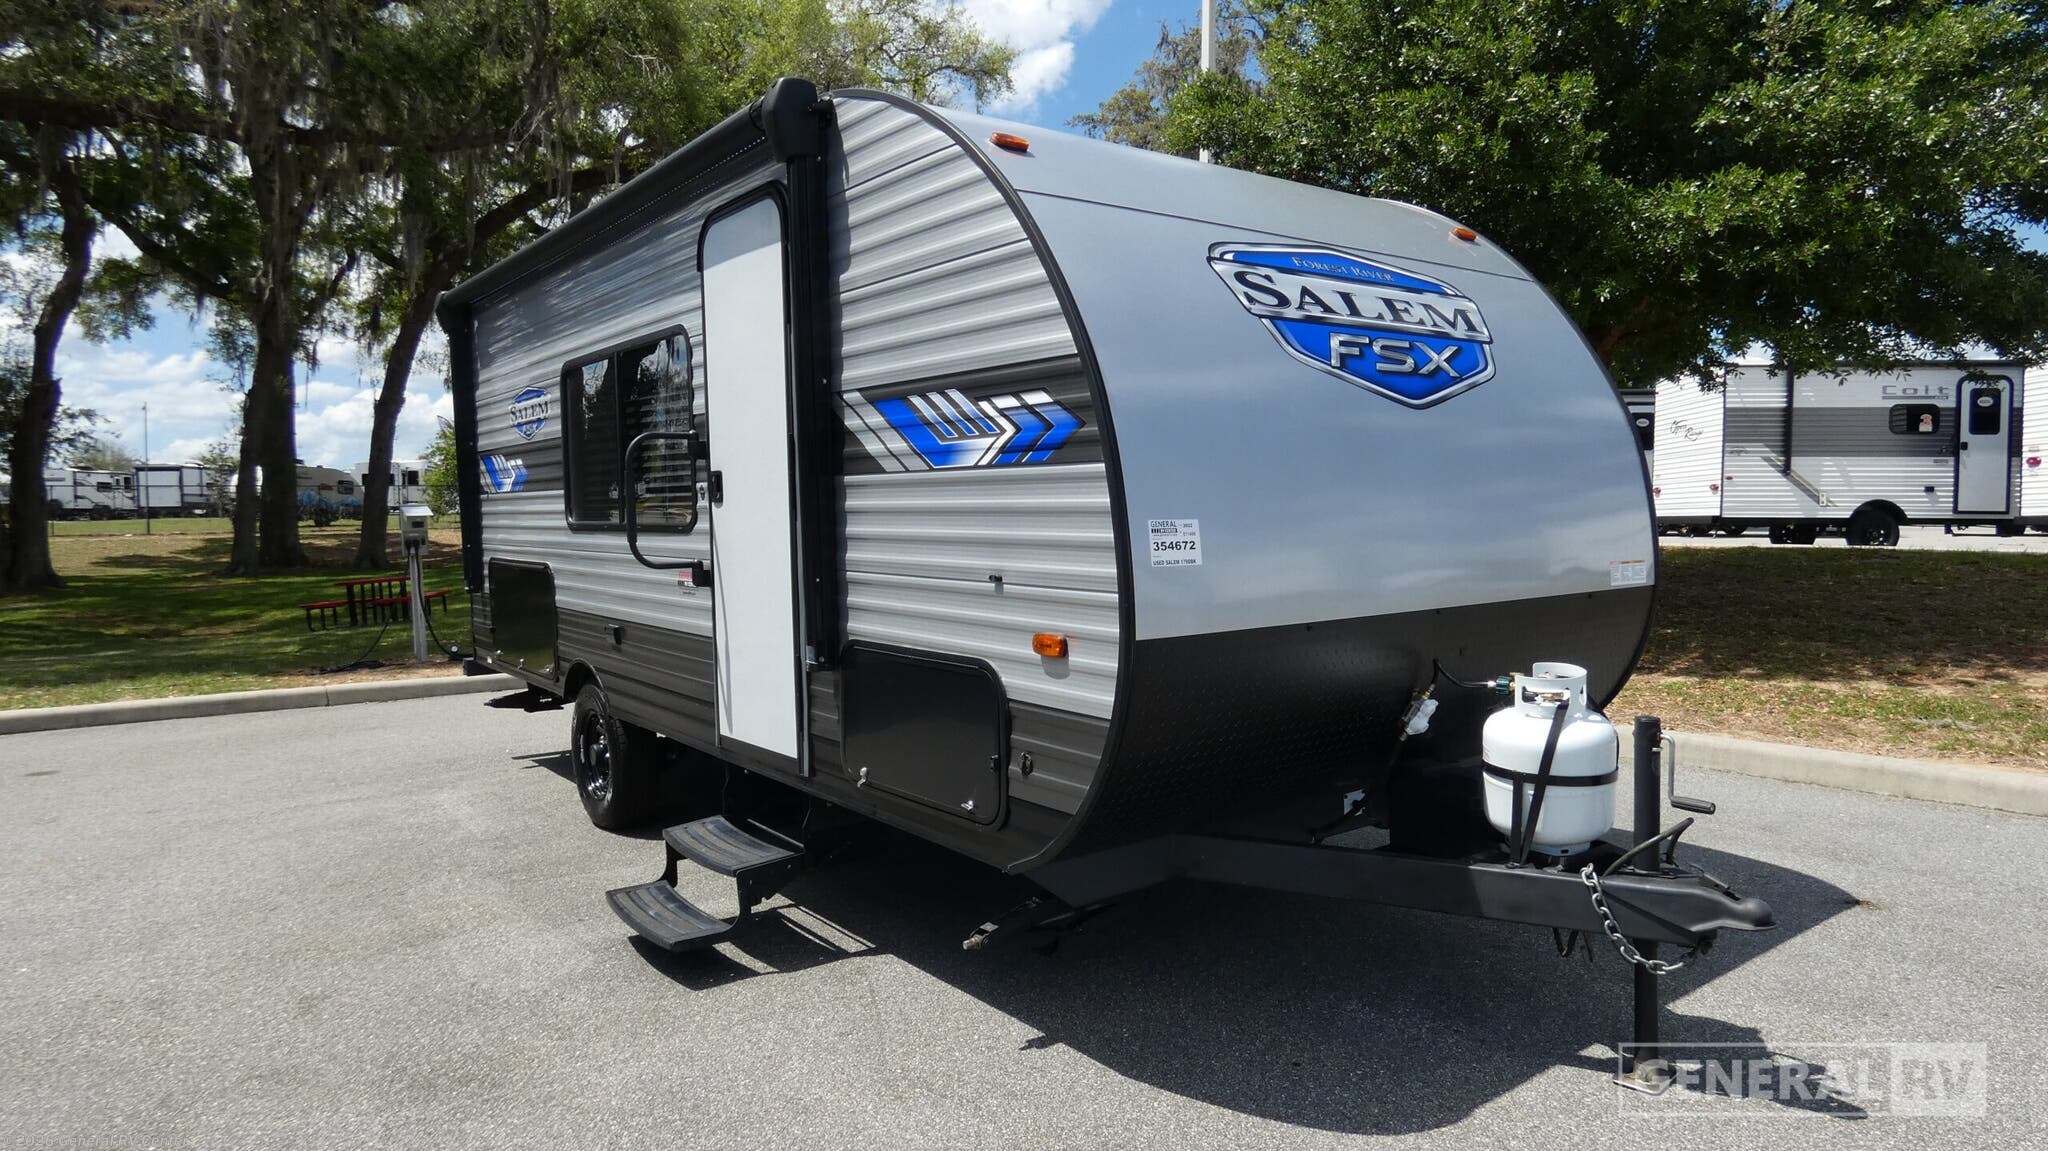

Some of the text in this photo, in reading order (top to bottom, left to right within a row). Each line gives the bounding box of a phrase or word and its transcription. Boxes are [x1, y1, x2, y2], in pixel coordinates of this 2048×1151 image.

[1233, 270, 1487, 336] SALEM
[1329, 332, 1463, 378] FSX
[1881, 384, 1951, 395] Colt
[511, 402, 549, 422] SALEM
[1153, 541, 1196, 551] 354672
